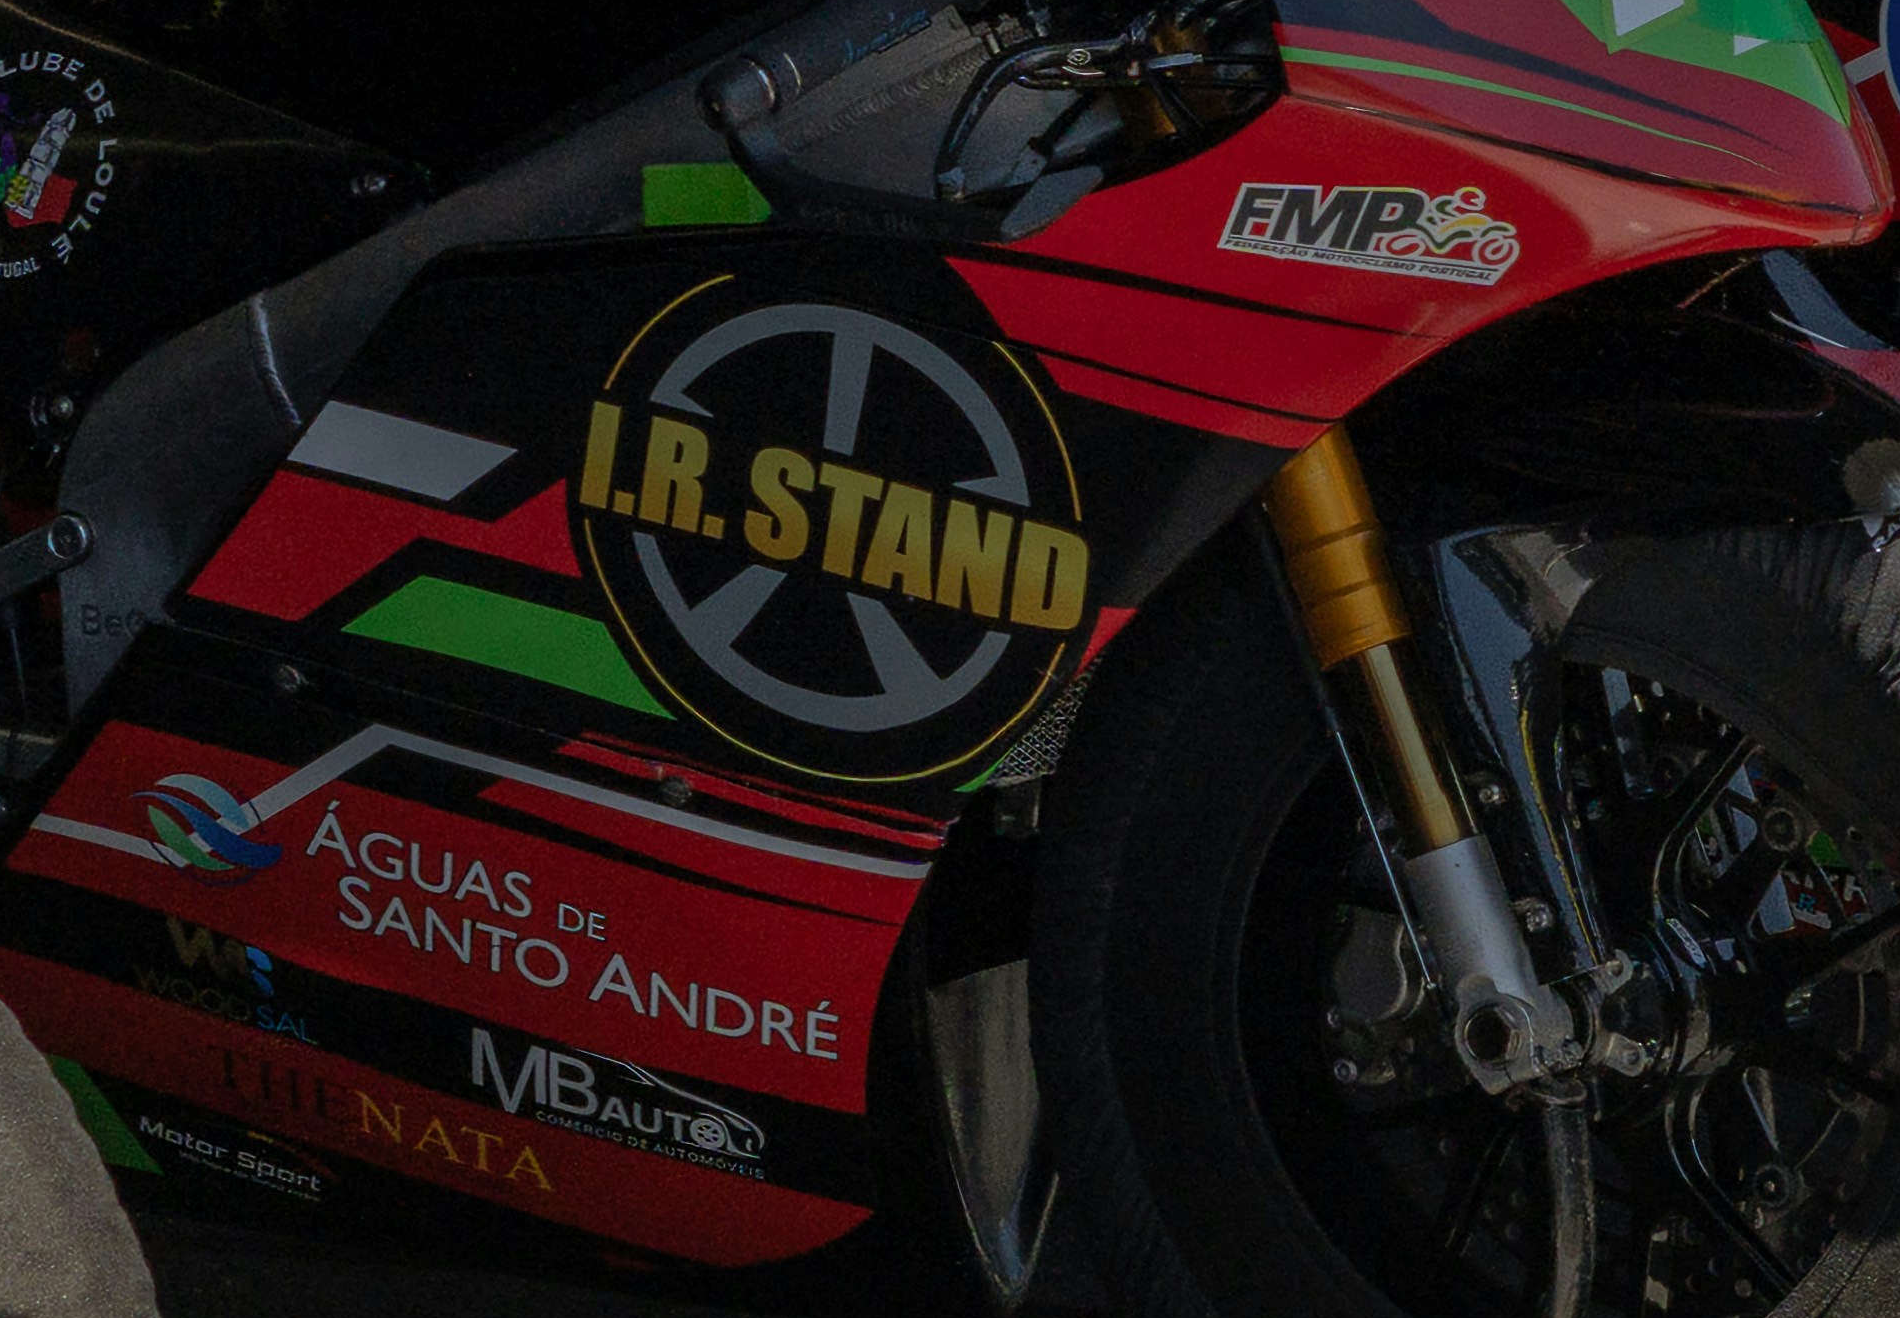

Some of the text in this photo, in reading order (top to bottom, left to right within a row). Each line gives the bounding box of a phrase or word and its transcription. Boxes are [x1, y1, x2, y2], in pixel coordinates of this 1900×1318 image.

[84, 79, 118, 125] DE
[1227, 183, 1429, 253] FMP
[578, 400, 1091, 632] I.R. STAND
[305, 800, 608, 943] ÁGUAS DE
[338, 875, 569, 990] SANTO
[589, 951, 840, 1062] ANDRÉ
[138, 1114, 229, 1160] Motor
[237, 1149, 324, 1193] Sport
[350, 1088, 555, 1192] NATA
